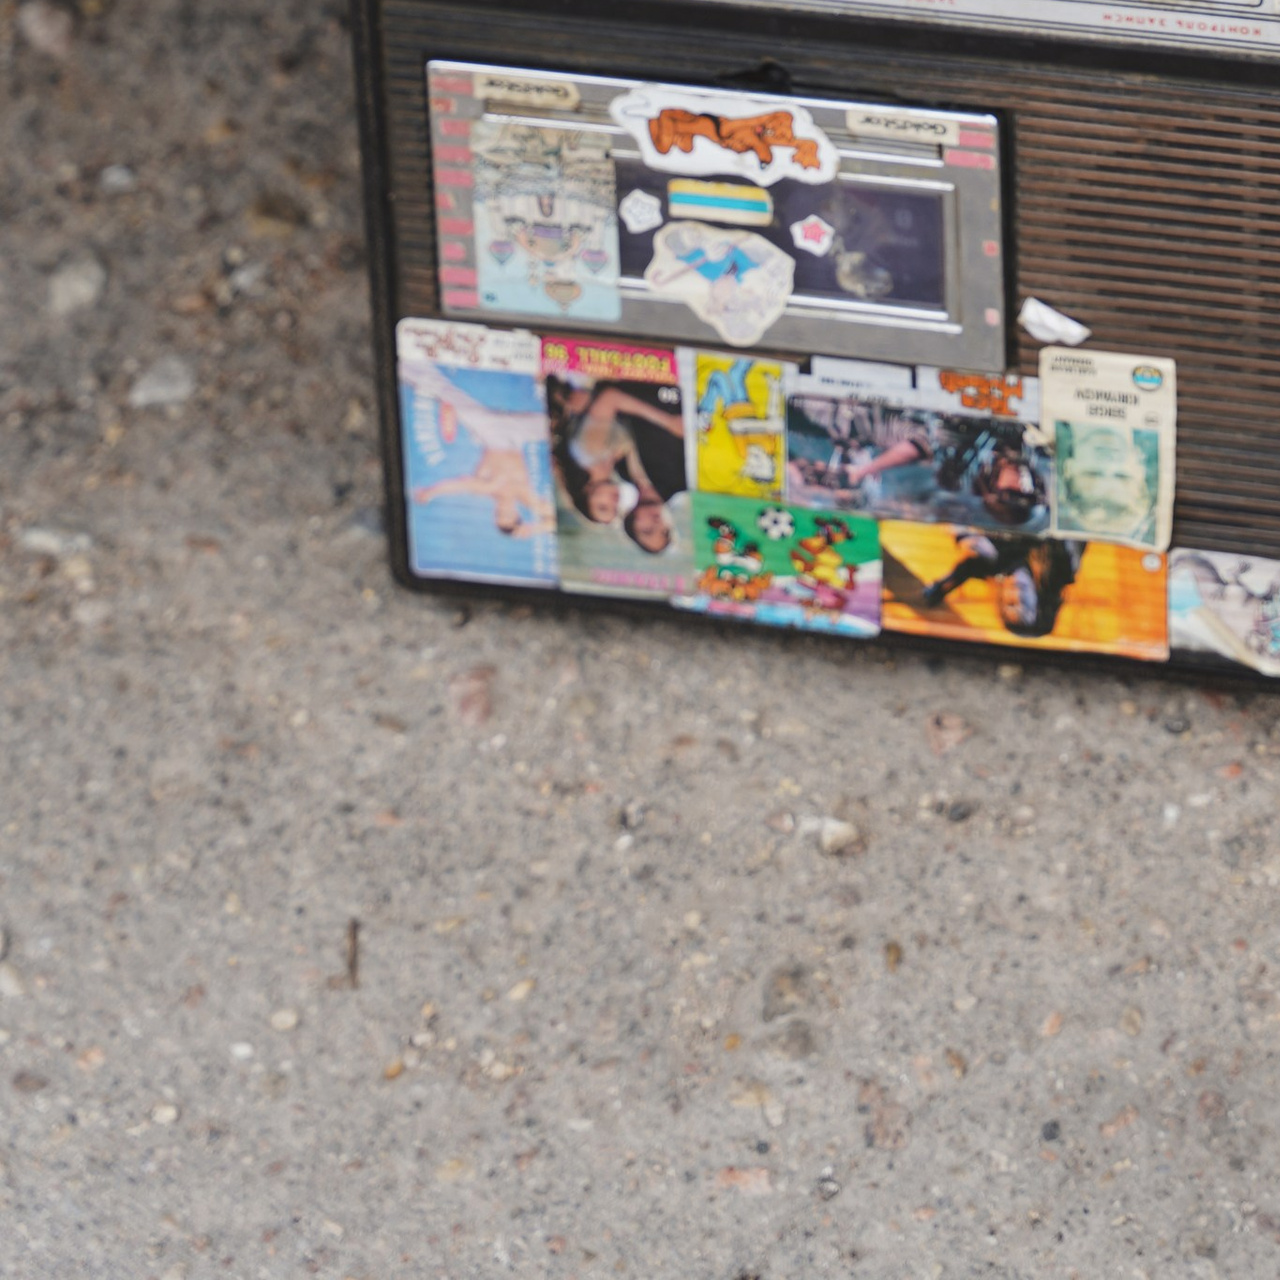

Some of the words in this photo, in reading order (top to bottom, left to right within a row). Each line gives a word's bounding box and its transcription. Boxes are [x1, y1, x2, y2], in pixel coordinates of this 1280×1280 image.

[1102, 12, 1168, 28] ЗАПИСИ
[1175, 19, 1263, 37] КОНТРОЛЬ
[860, 115, 948, 136] GoldStar
